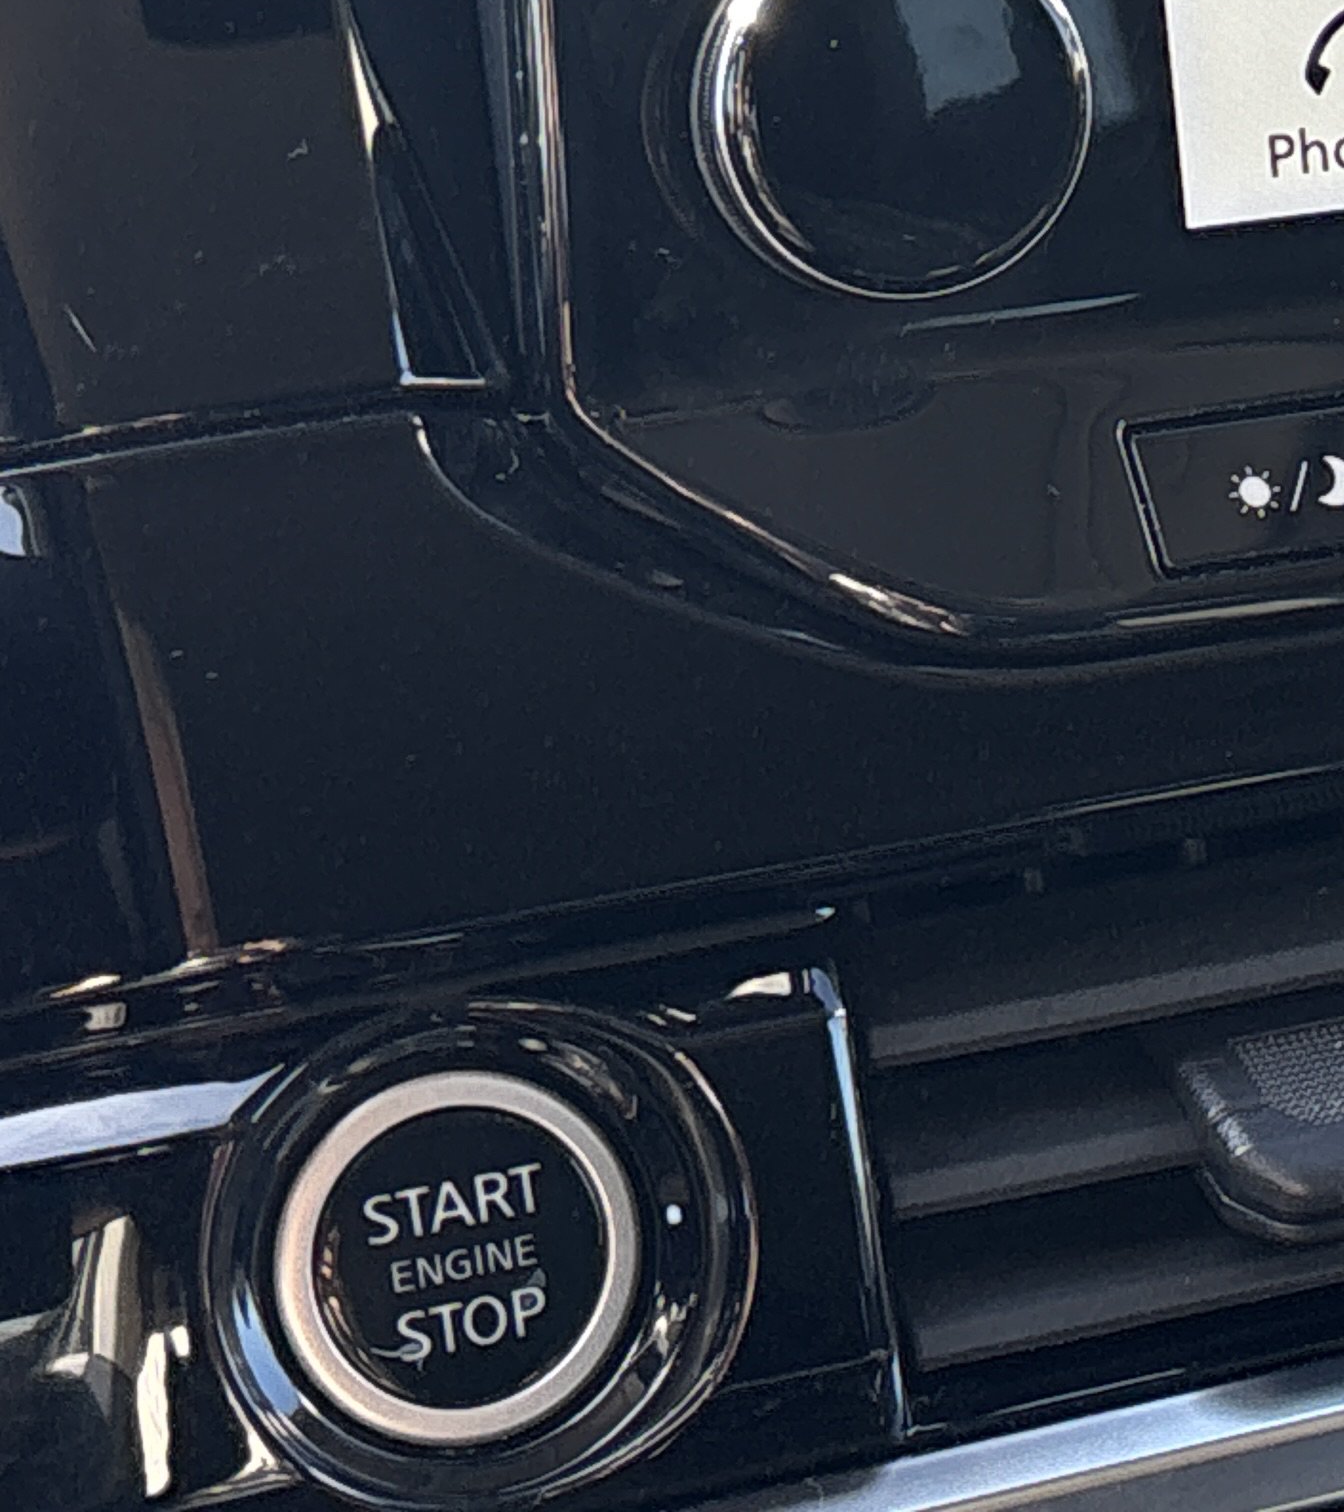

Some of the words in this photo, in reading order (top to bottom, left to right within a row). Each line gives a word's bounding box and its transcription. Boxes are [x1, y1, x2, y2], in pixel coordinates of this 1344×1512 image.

[362, 1162, 542, 1247] START
[390, 1233, 539, 1294] ENGINE
[396, 1286, 547, 1364] STOP
